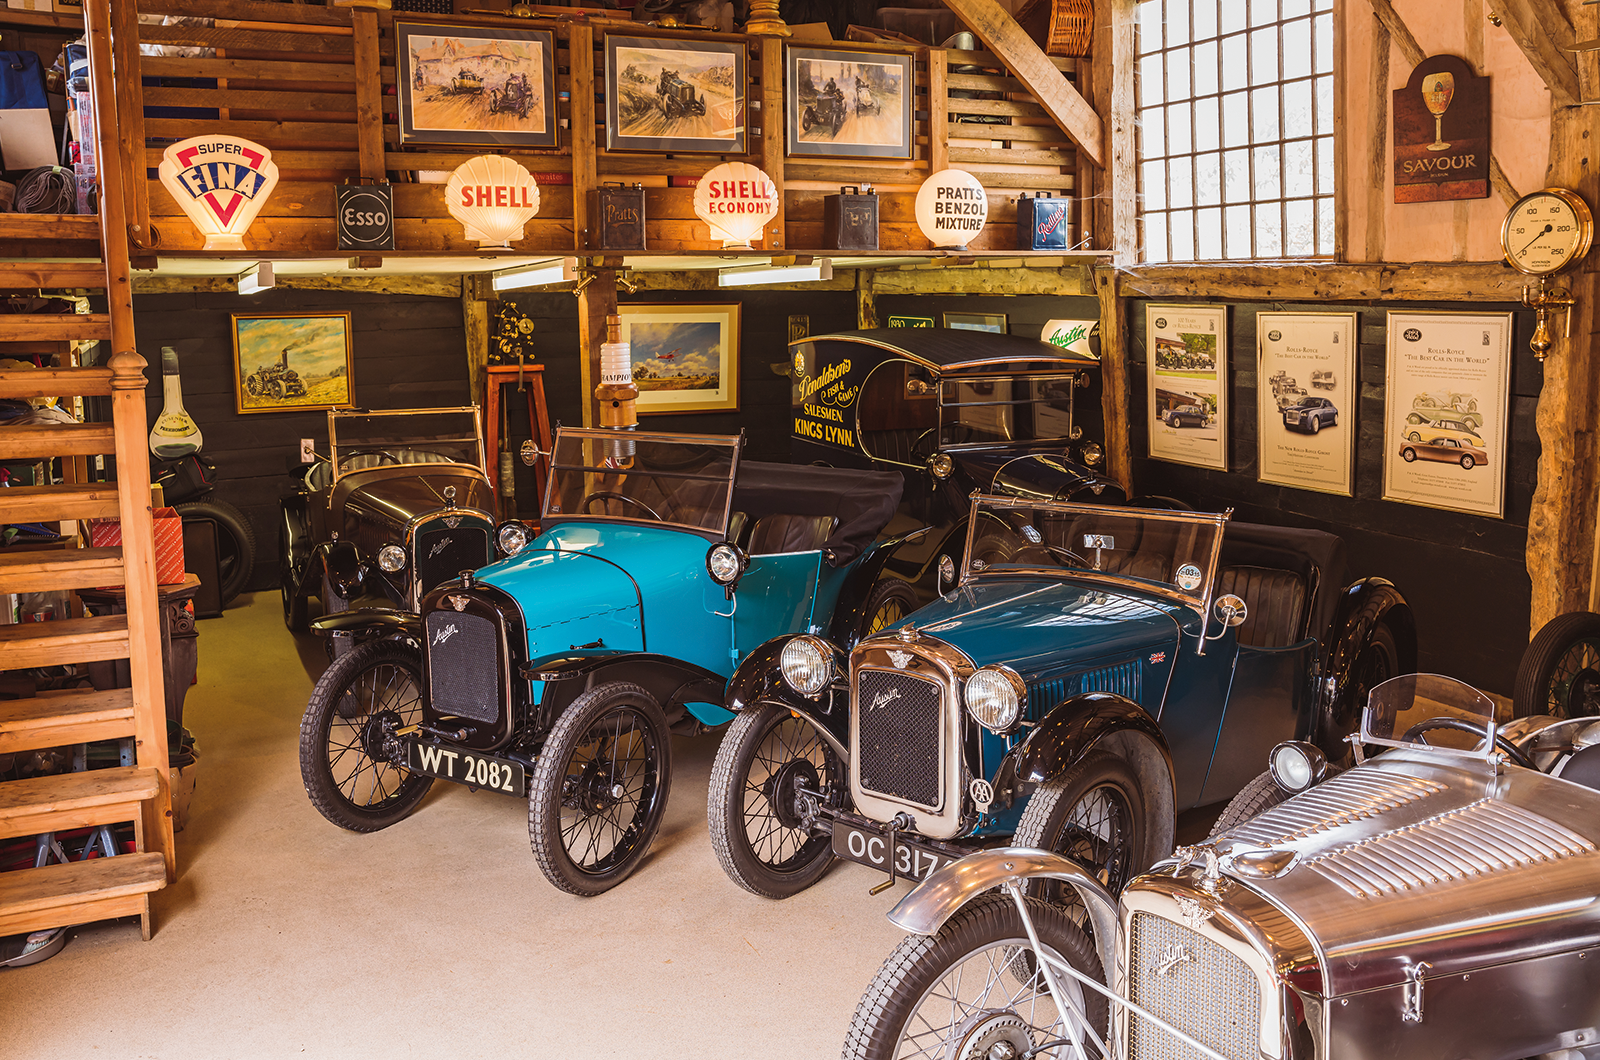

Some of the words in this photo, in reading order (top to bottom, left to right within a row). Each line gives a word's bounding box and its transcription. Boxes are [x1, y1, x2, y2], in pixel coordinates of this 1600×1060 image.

[198, 143, 242, 155] SUPER
[1403, 154, 1477, 173] SAVOUR
[180, 162, 257, 199] FINA
[709, 180, 771, 199] SHELL
[461, 185, 533, 208] SHELL
[937, 187, 982, 200] PRATTS
[605, 204, 640, 225] Pratts
[709, 202, 772, 214] ECONOMY
[935, 202, 985, 216] BENZOL
[935, 217, 983, 230] MIXTURE
[1049, 324, 1087, 348] Austin
[1286, 346, 1318, 354] ROLLS-ROYCE
[1427, 347, 1465, 355] ROLLS-ROYCE
[798, 358, 852, 402] Donaldson's
[827, 383, 840, 398] FISH
[840, 380, 845, 391] &
[838, 387, 854, 402] GAME
[794, 417, 823, 440] KINGS
[825, 425, 855, 448] LYNN.
[1185, 568, 1194, 577] 03
[432, 623, 459, 646] Austin
[869, 688, 902, 712] Austin
[417, 743, 459, 777] WT
[464, 755, 514, 792] 2082
[847, 830, 885, 864] OC
[894, 845, 953, 881] 317
[1145, 943, 1190, 975] Austin
